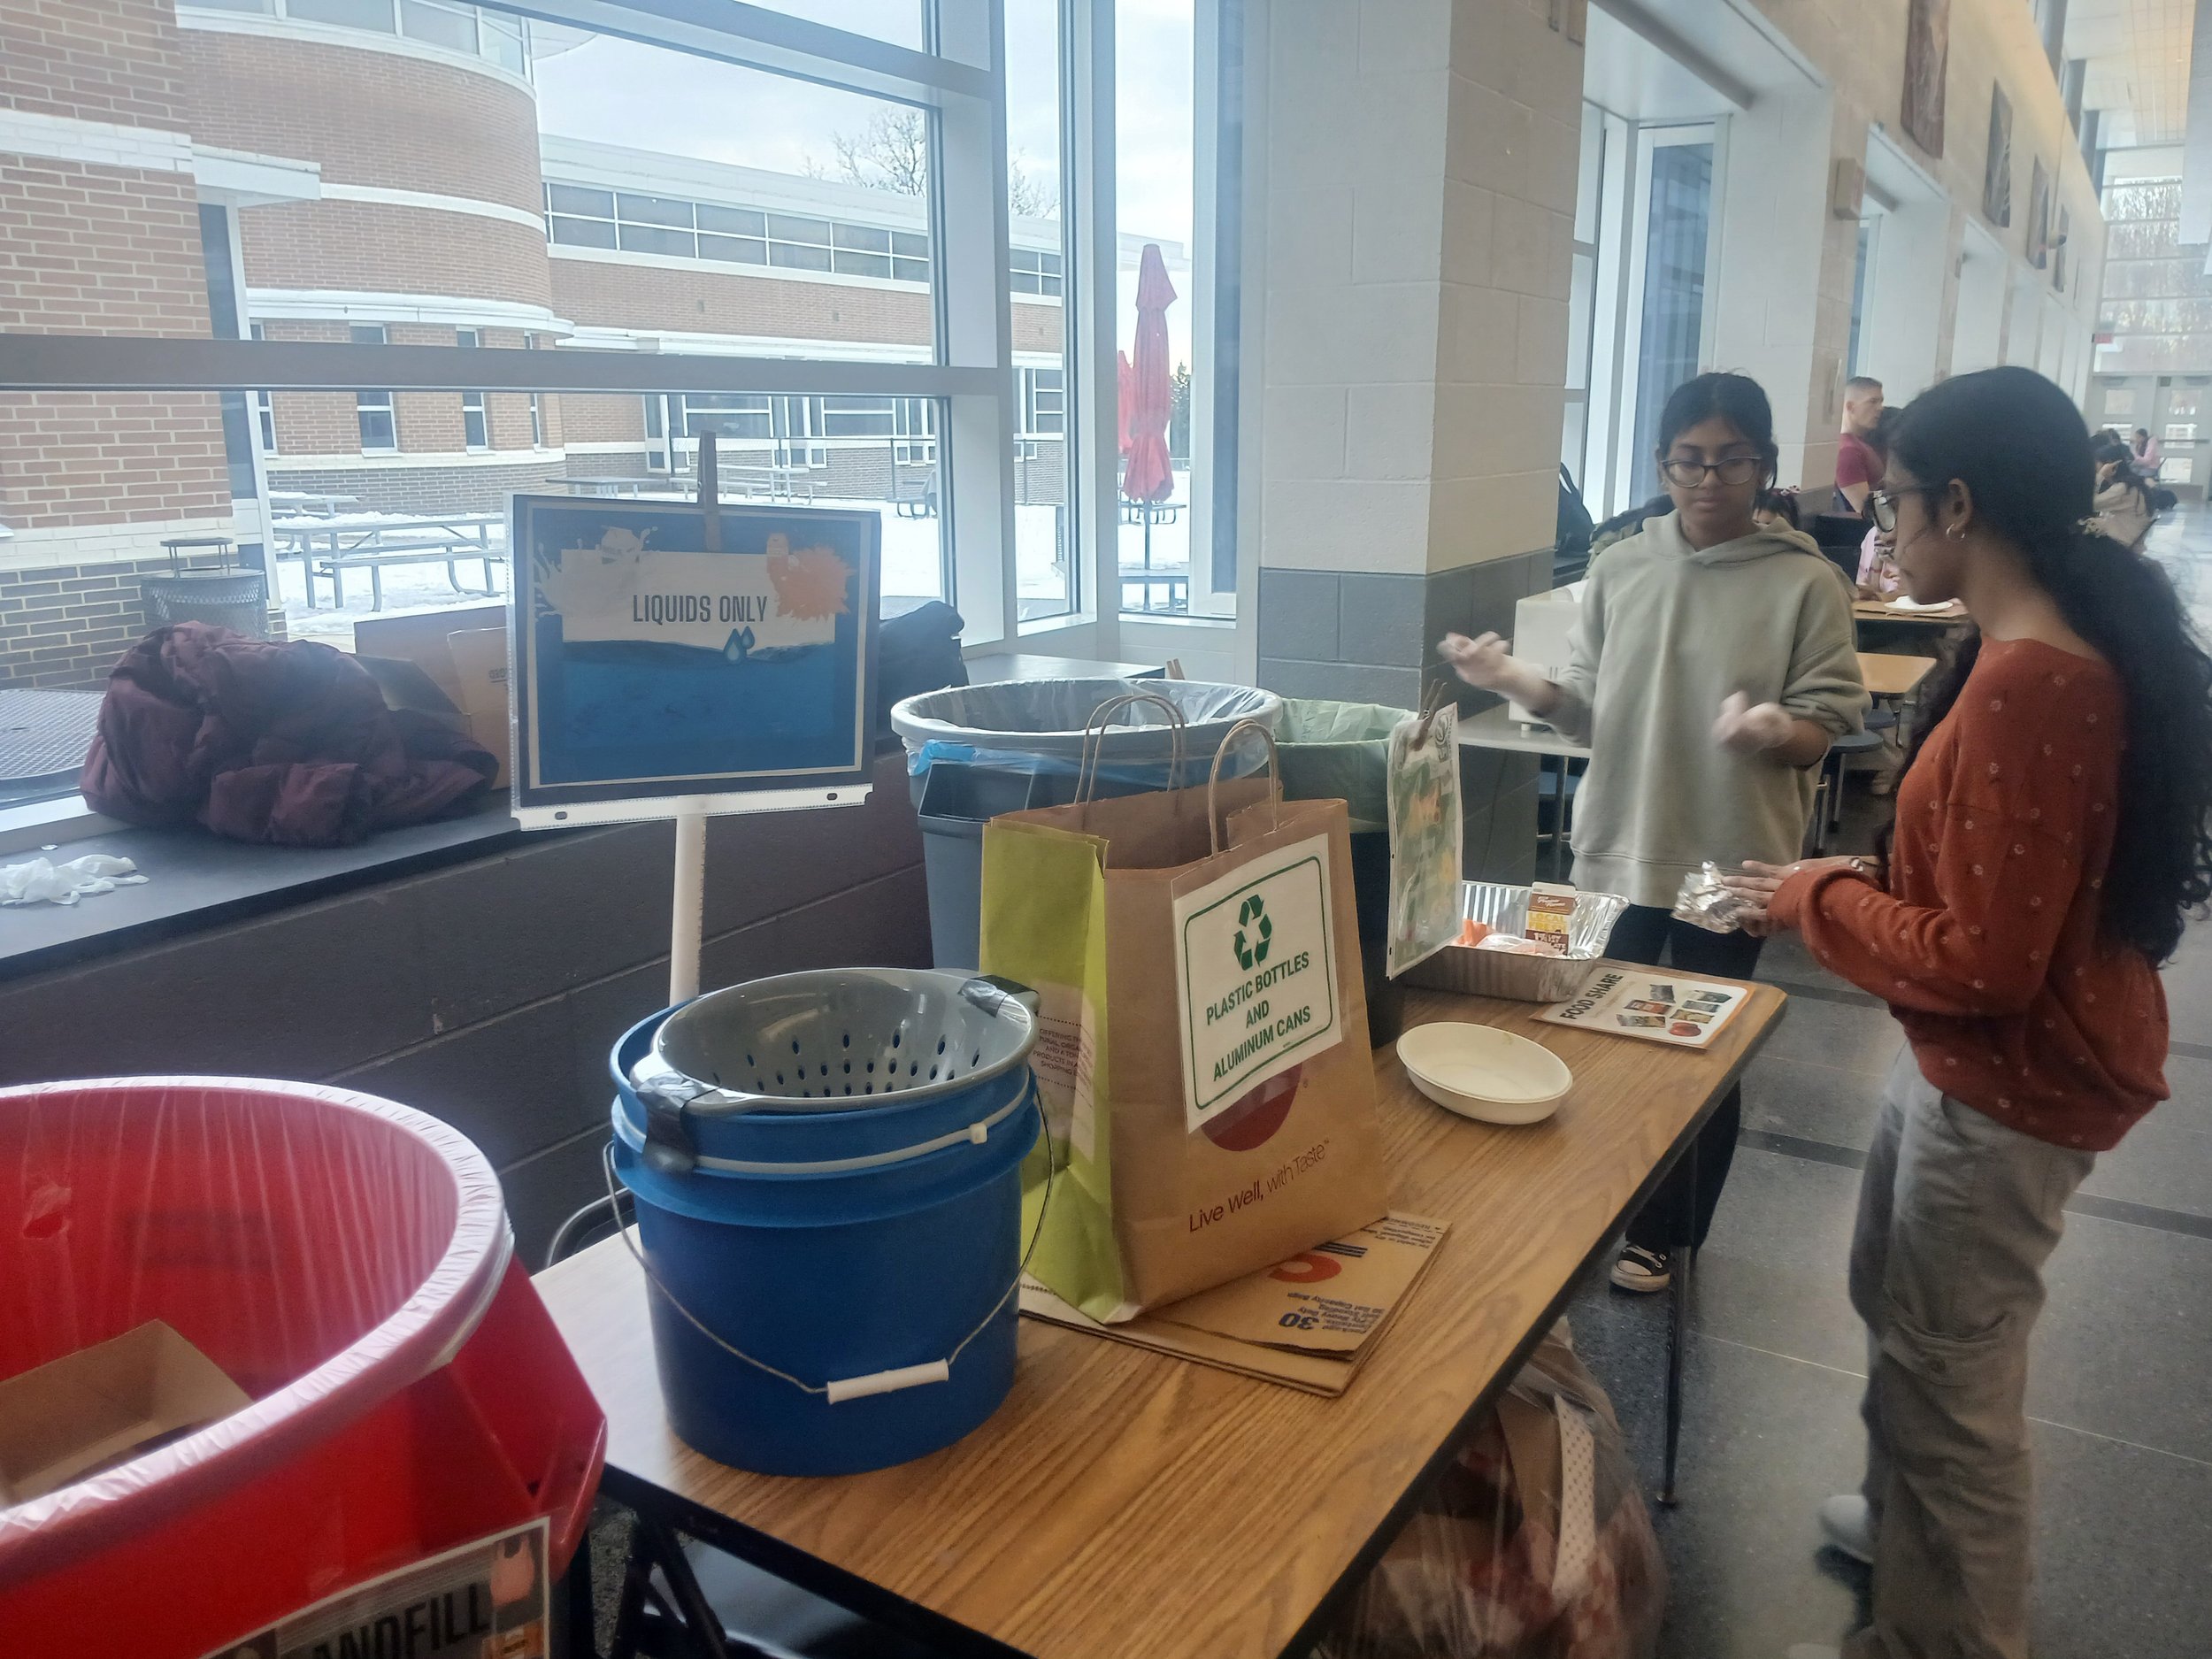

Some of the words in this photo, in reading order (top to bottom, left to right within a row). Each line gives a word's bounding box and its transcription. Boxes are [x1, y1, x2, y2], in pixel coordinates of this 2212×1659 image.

[633, 595, 711, 626] LIQUIDS
[719, 595, 768, 623] ONLY
[1206, 980, 1253, 1026] PLASTIC
[1255, 951, 1310, 994] BOTTLES
[1559, 999, 1595, 1020] FOOD
[1585, 973, 1624, 999] SHARE
[1246, 1000, 1270, 1029] AND
[1039, 1028, 1072, 1042] OFFERING
[1213, 1025, 1274, 1082] ALUMINUM
[1277, 1005, 1311, 1037] CANS
[1189, 1206, 1224, 1233] Live
[1228, 1179, 1263, 1213] Well,
[1267, 1164, 1294, 1193] with
[1279, 1312, 1319, 1330] 30
